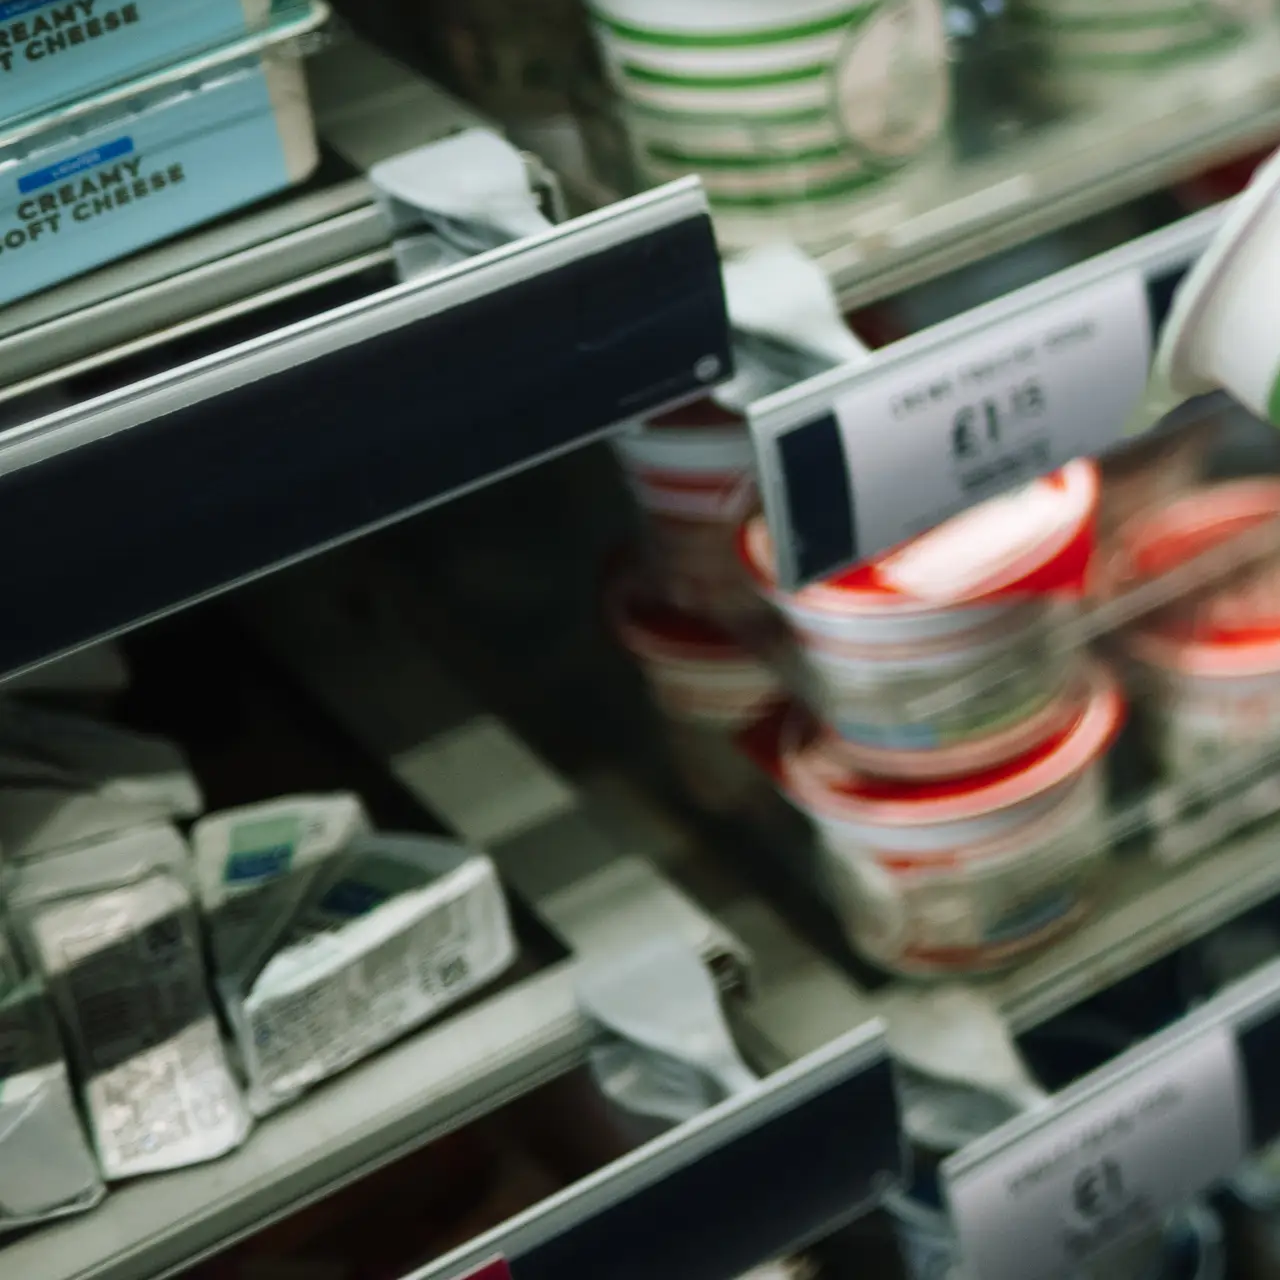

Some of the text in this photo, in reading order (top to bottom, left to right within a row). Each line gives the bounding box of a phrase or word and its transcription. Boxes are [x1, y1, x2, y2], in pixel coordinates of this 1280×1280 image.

[25, 1, 140, 61] CHEESE
[0, 161, 186, 254] OFT CHEESE
[17, 155, 143, 220] CREAMY
